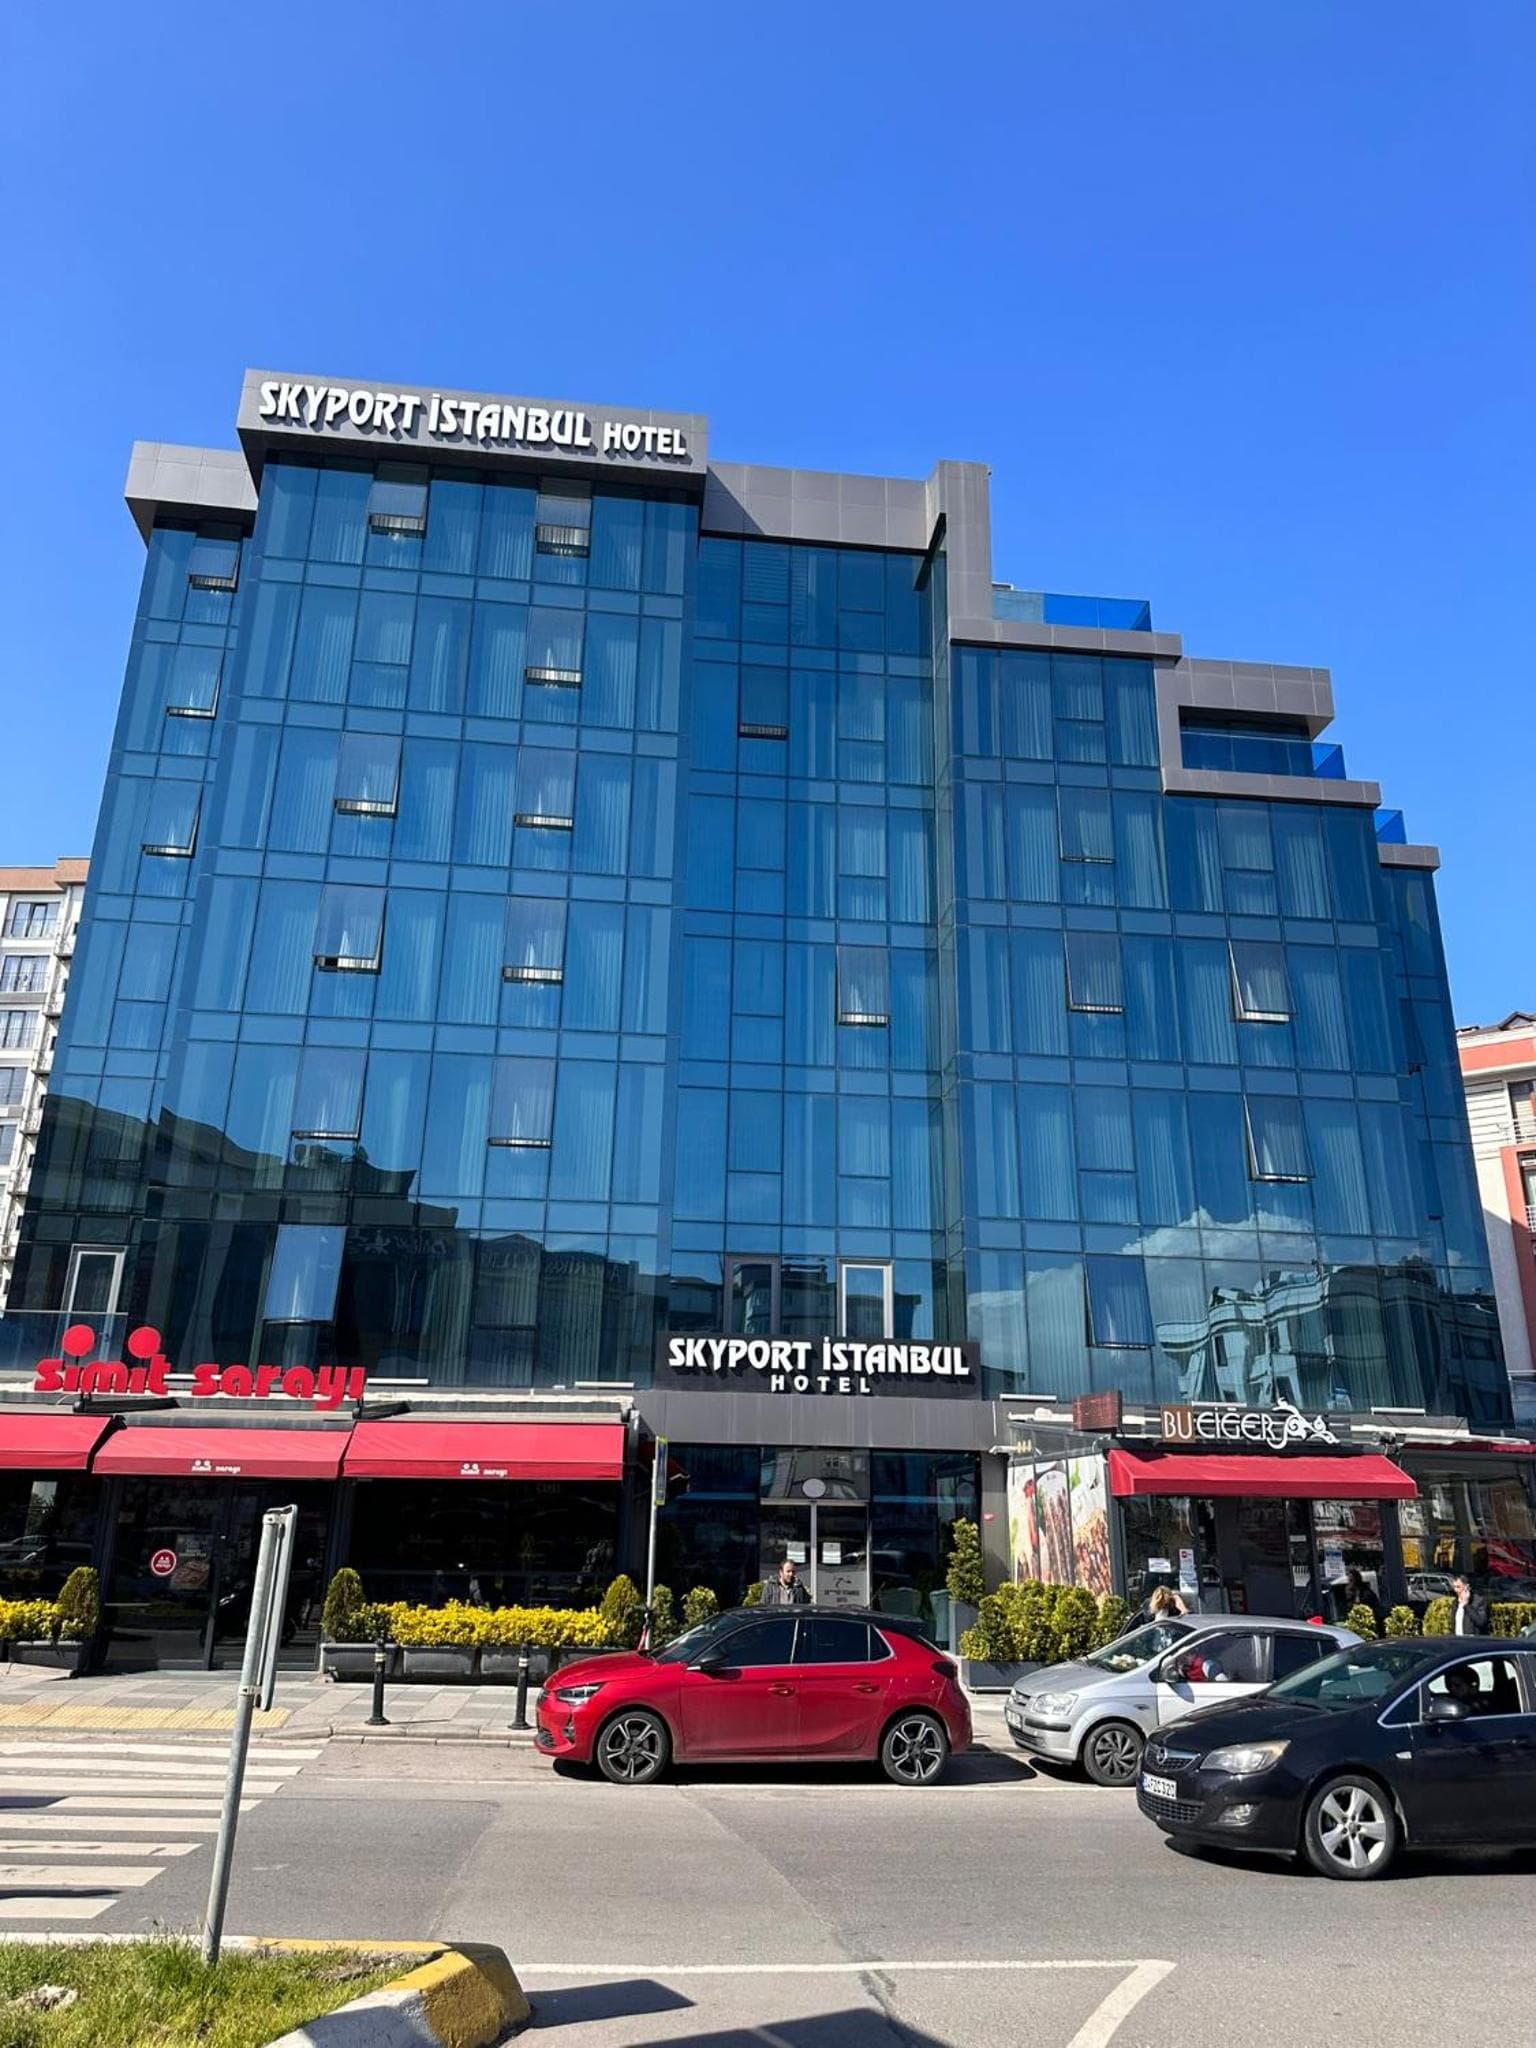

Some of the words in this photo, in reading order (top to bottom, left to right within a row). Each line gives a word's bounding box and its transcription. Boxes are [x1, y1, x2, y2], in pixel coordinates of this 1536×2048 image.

[259, 381, 421, 434] SKYPORT
[428, 393, 591, 446] İSTANBUL
[604, 422, 686, 455] HOTEL
[34, 1325, 172, 1395] simit
[191, 1364, 366, 1411] sarayı
[669, 1338, 811, 1372] SKYPORT
[823, 1337, 969, 1375] İSTANBUL
[771, 1375, 870, 1393] HOTEL
[1163, 1411, 1192, 1439] BU
